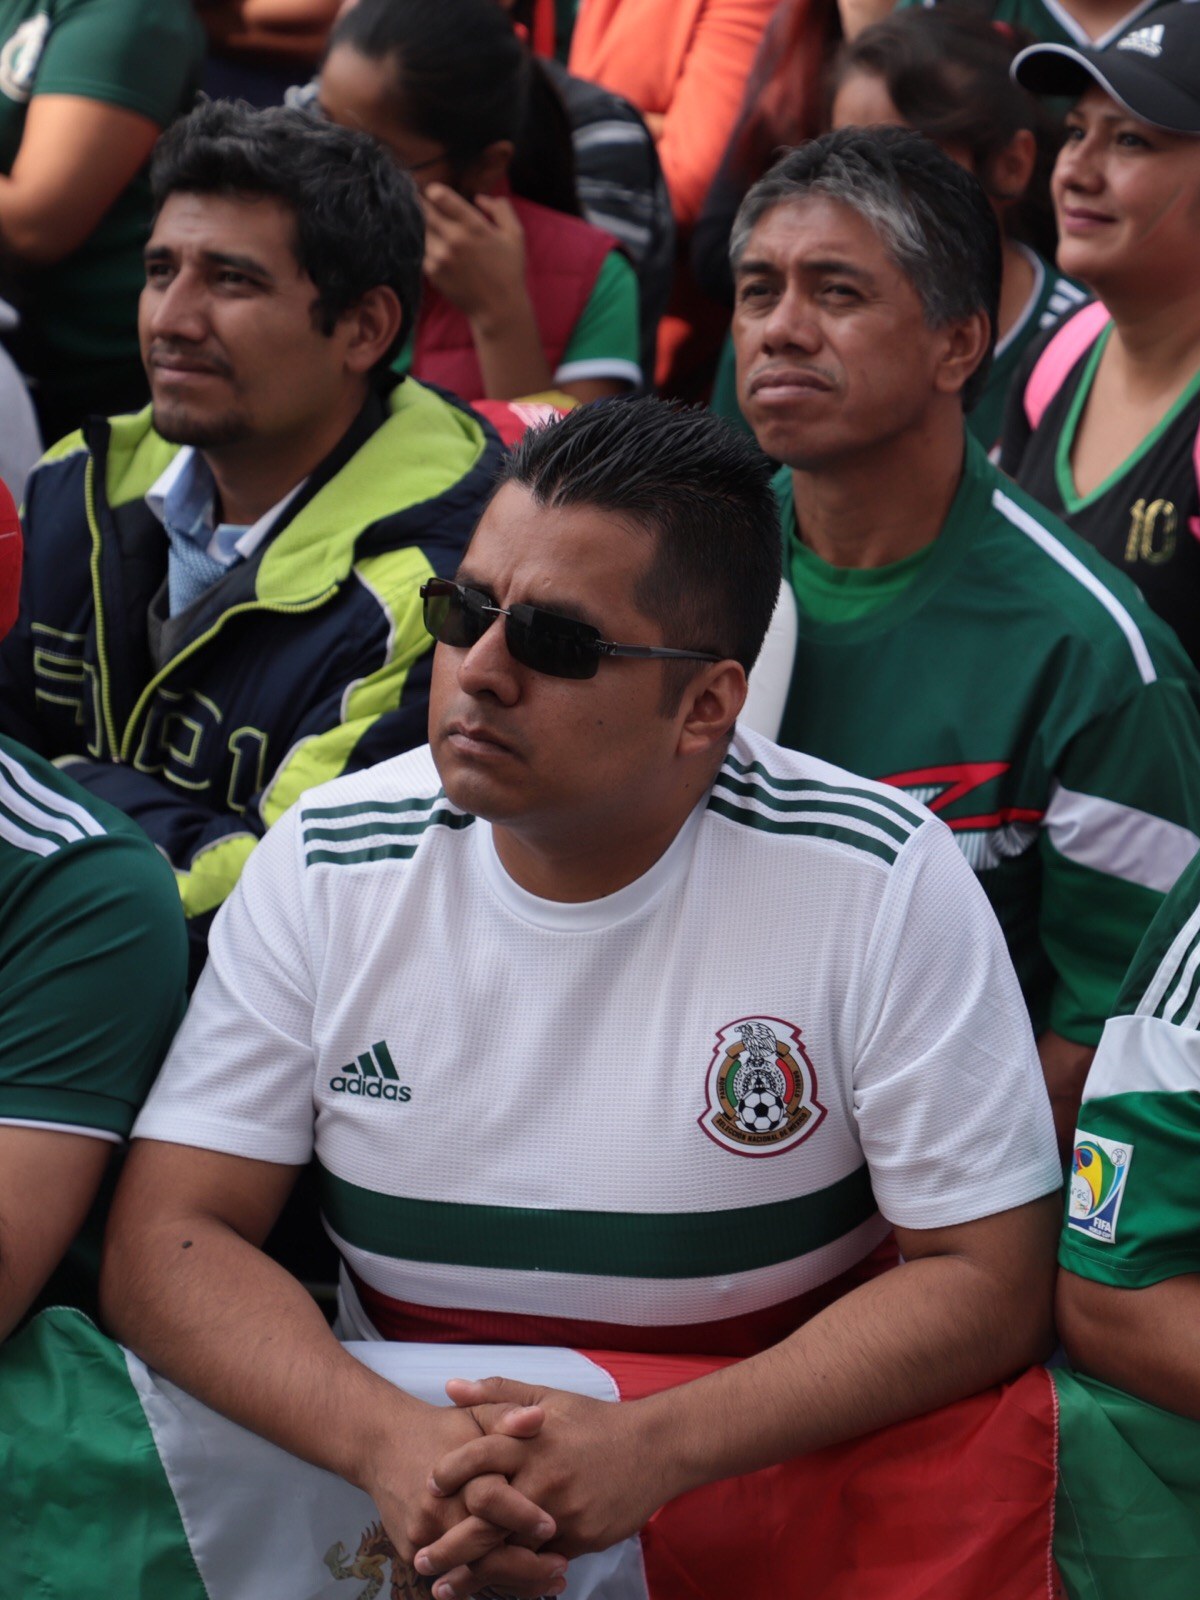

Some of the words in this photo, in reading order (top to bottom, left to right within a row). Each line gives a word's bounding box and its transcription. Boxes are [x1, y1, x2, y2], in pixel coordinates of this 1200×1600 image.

[1124, 498, 1178, 566] 10
[329, 1074, 413, 1103] adidas
[1093, 1216, 1112, 1234] FIFA
